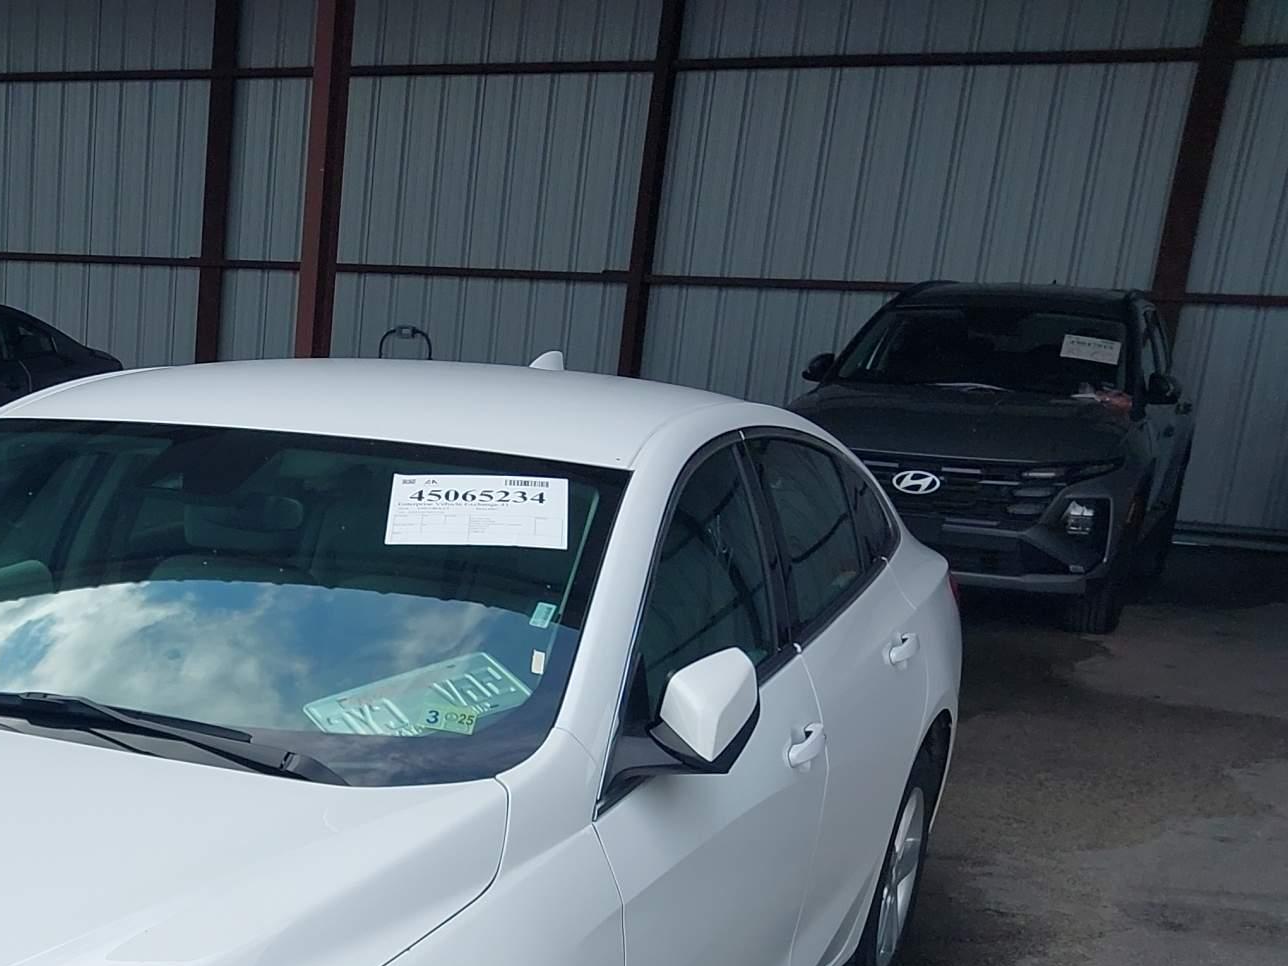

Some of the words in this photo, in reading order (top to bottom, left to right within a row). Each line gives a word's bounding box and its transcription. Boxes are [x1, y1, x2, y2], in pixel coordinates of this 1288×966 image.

[409, 489, 546, 504] 45065234
[426, 710, 440, 724] 3
[457, 713, 475, 726] 25
